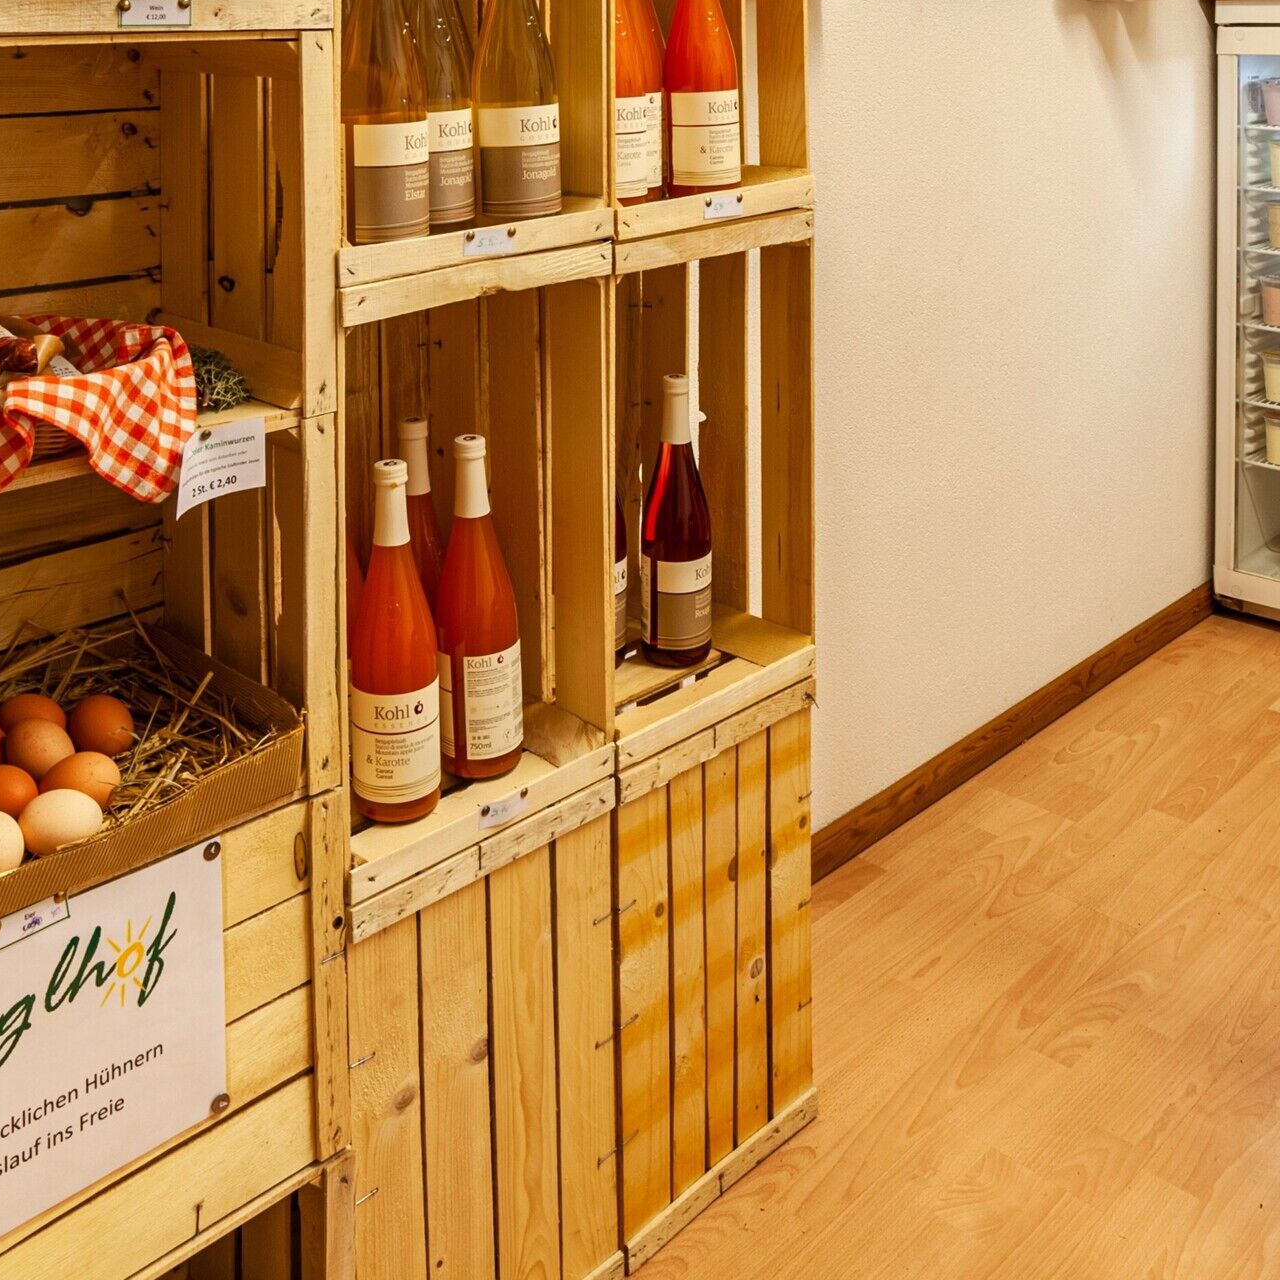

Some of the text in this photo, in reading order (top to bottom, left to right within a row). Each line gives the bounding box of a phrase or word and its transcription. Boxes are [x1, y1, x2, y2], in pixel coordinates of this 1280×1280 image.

[616, 106, 642, 122] Kohl
[707, 100, 733, 114] Kohl
[438, 121, 468, 138] Kohl
[520, 115, 551, 133] Kohl
[700, 145, 707, 154] &
[204, 435, 256, 451] Kaminwurzen
[192, 475, 238, 498] 2 St. € 2,40
[466, 657, 492, 670] Kohl
[374, 704, 410, 721] Kohl
[365, 754, 411, 767] & Karotte
[85, 1043, 164, 1094] Hühnern
[47, 1125, 74, 1150] ins
[79, 1097, 126, 1132] Freie
